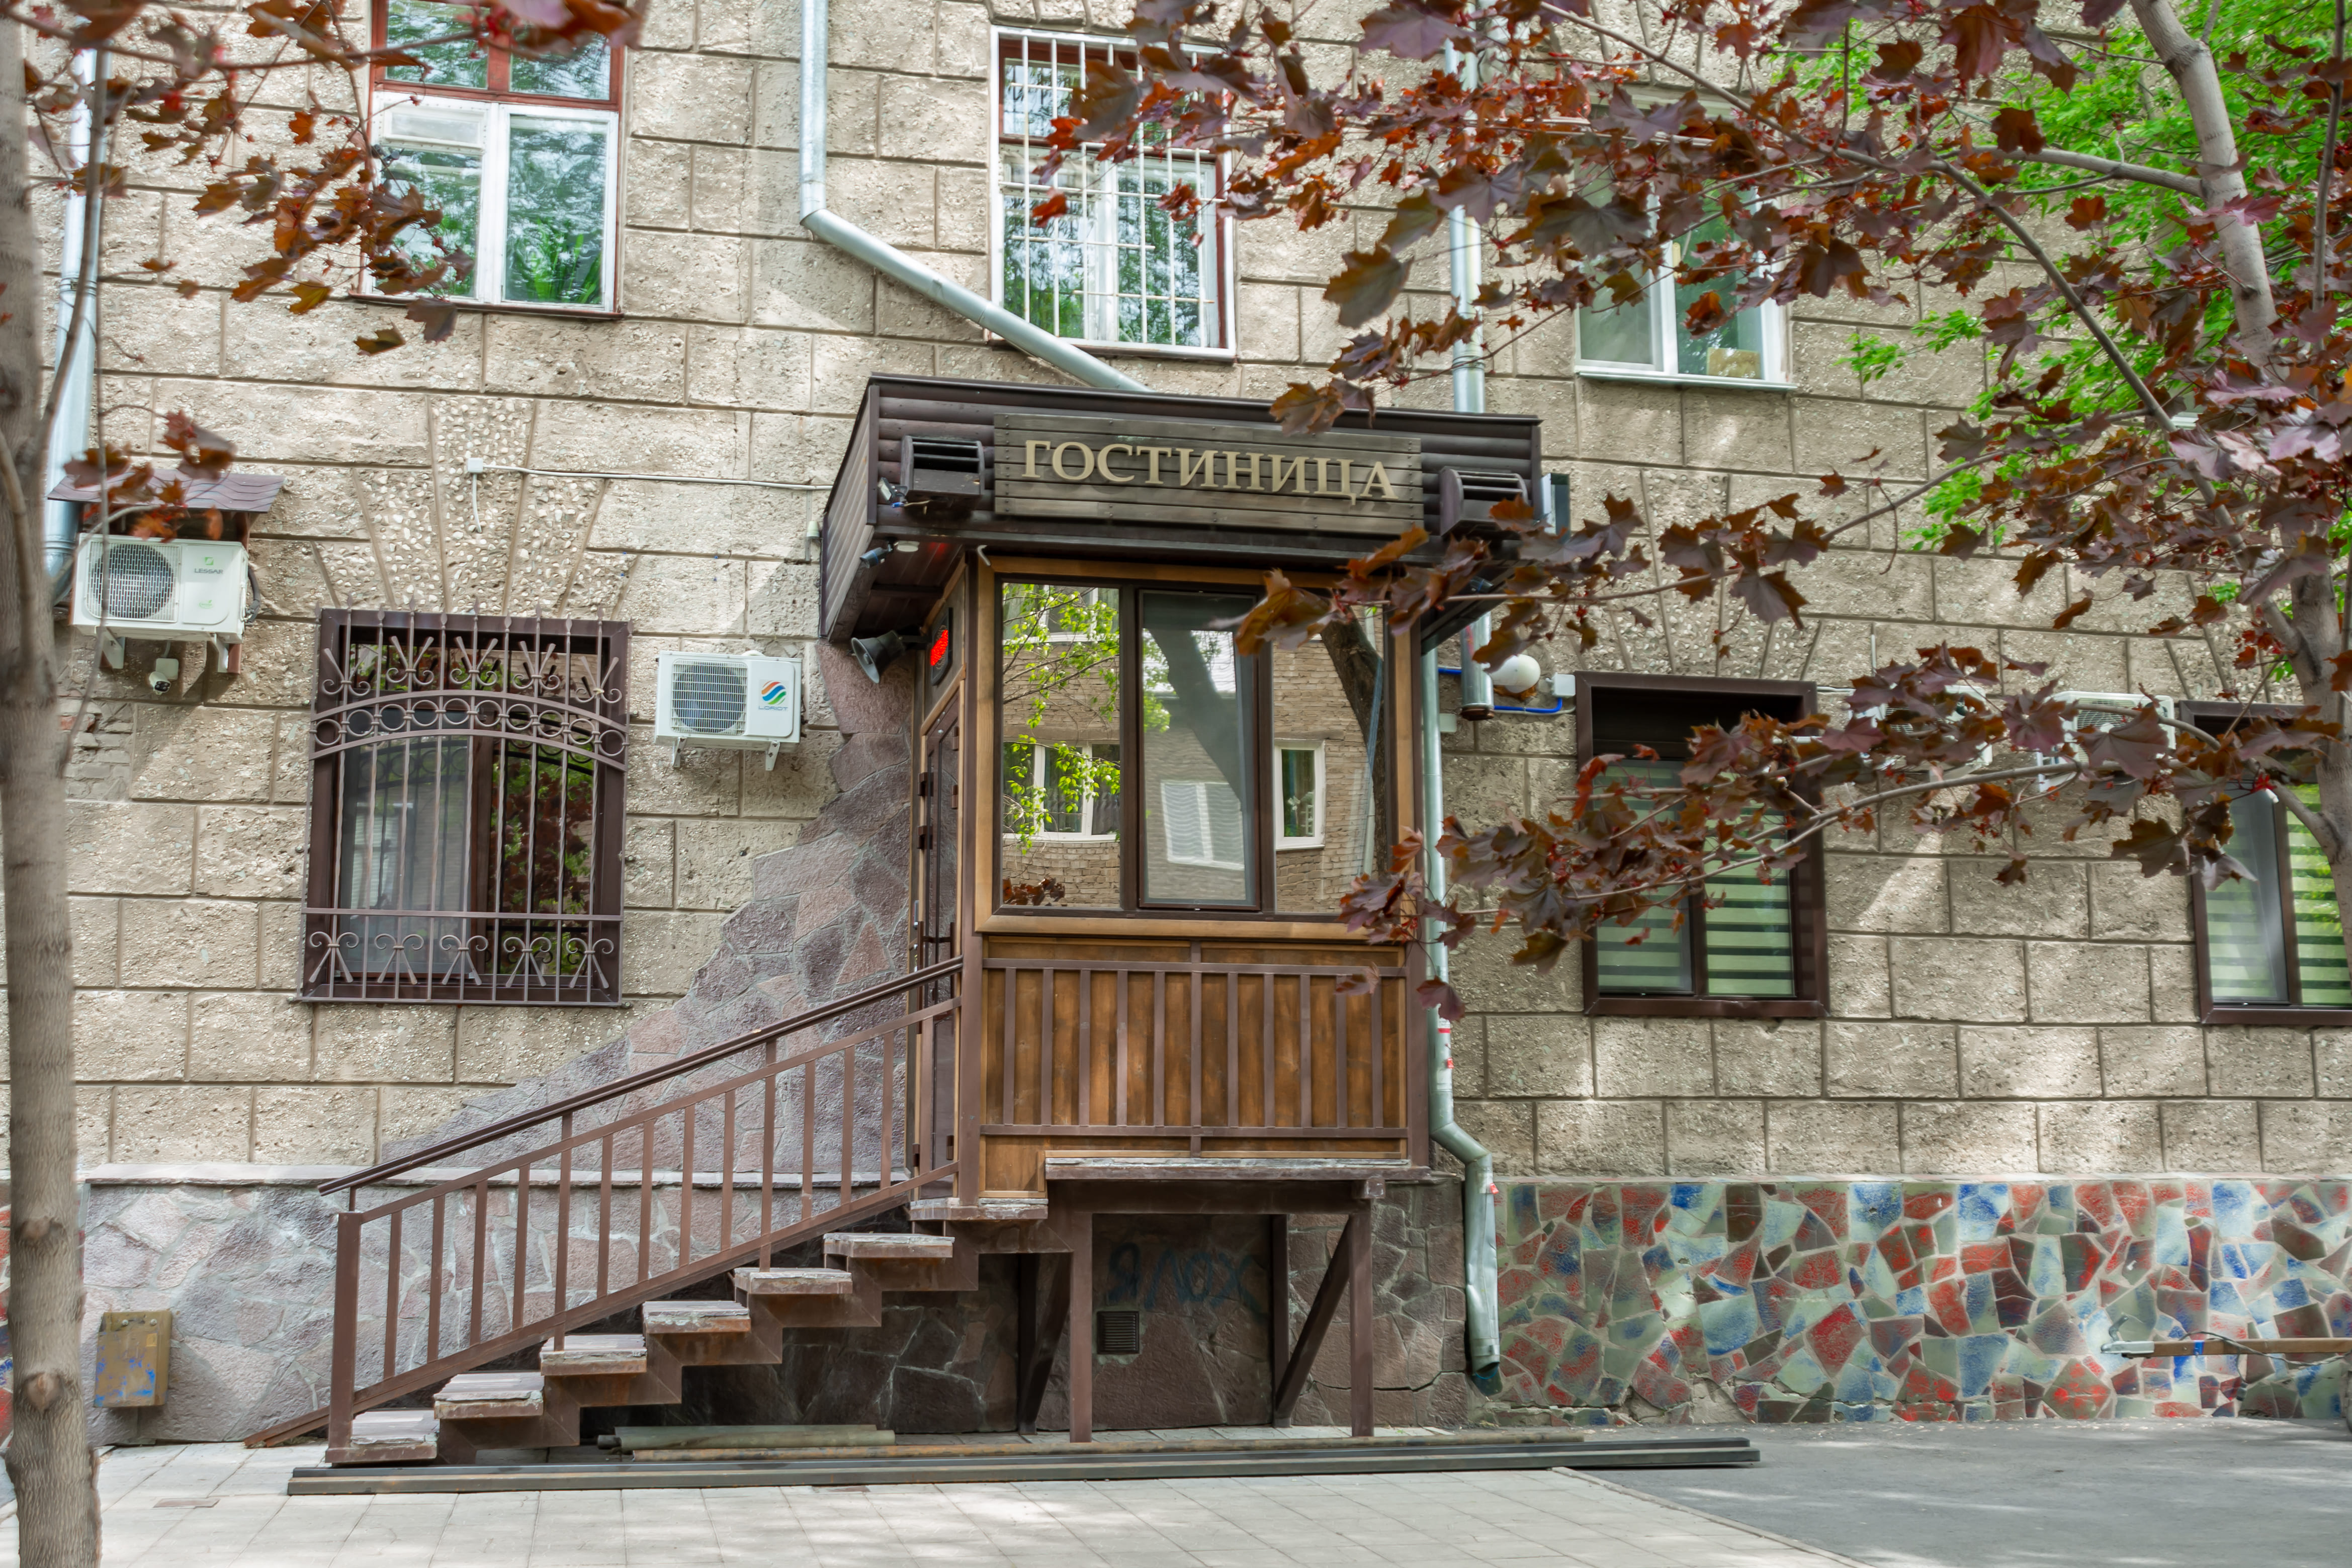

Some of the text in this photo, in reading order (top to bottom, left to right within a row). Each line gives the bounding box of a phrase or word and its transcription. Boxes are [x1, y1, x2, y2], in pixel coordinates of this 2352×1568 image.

[1021, 440, 1399, 505] ГОСТИНИЦА
[1108, 1242, 1266, 1324] Я ЛОХ
